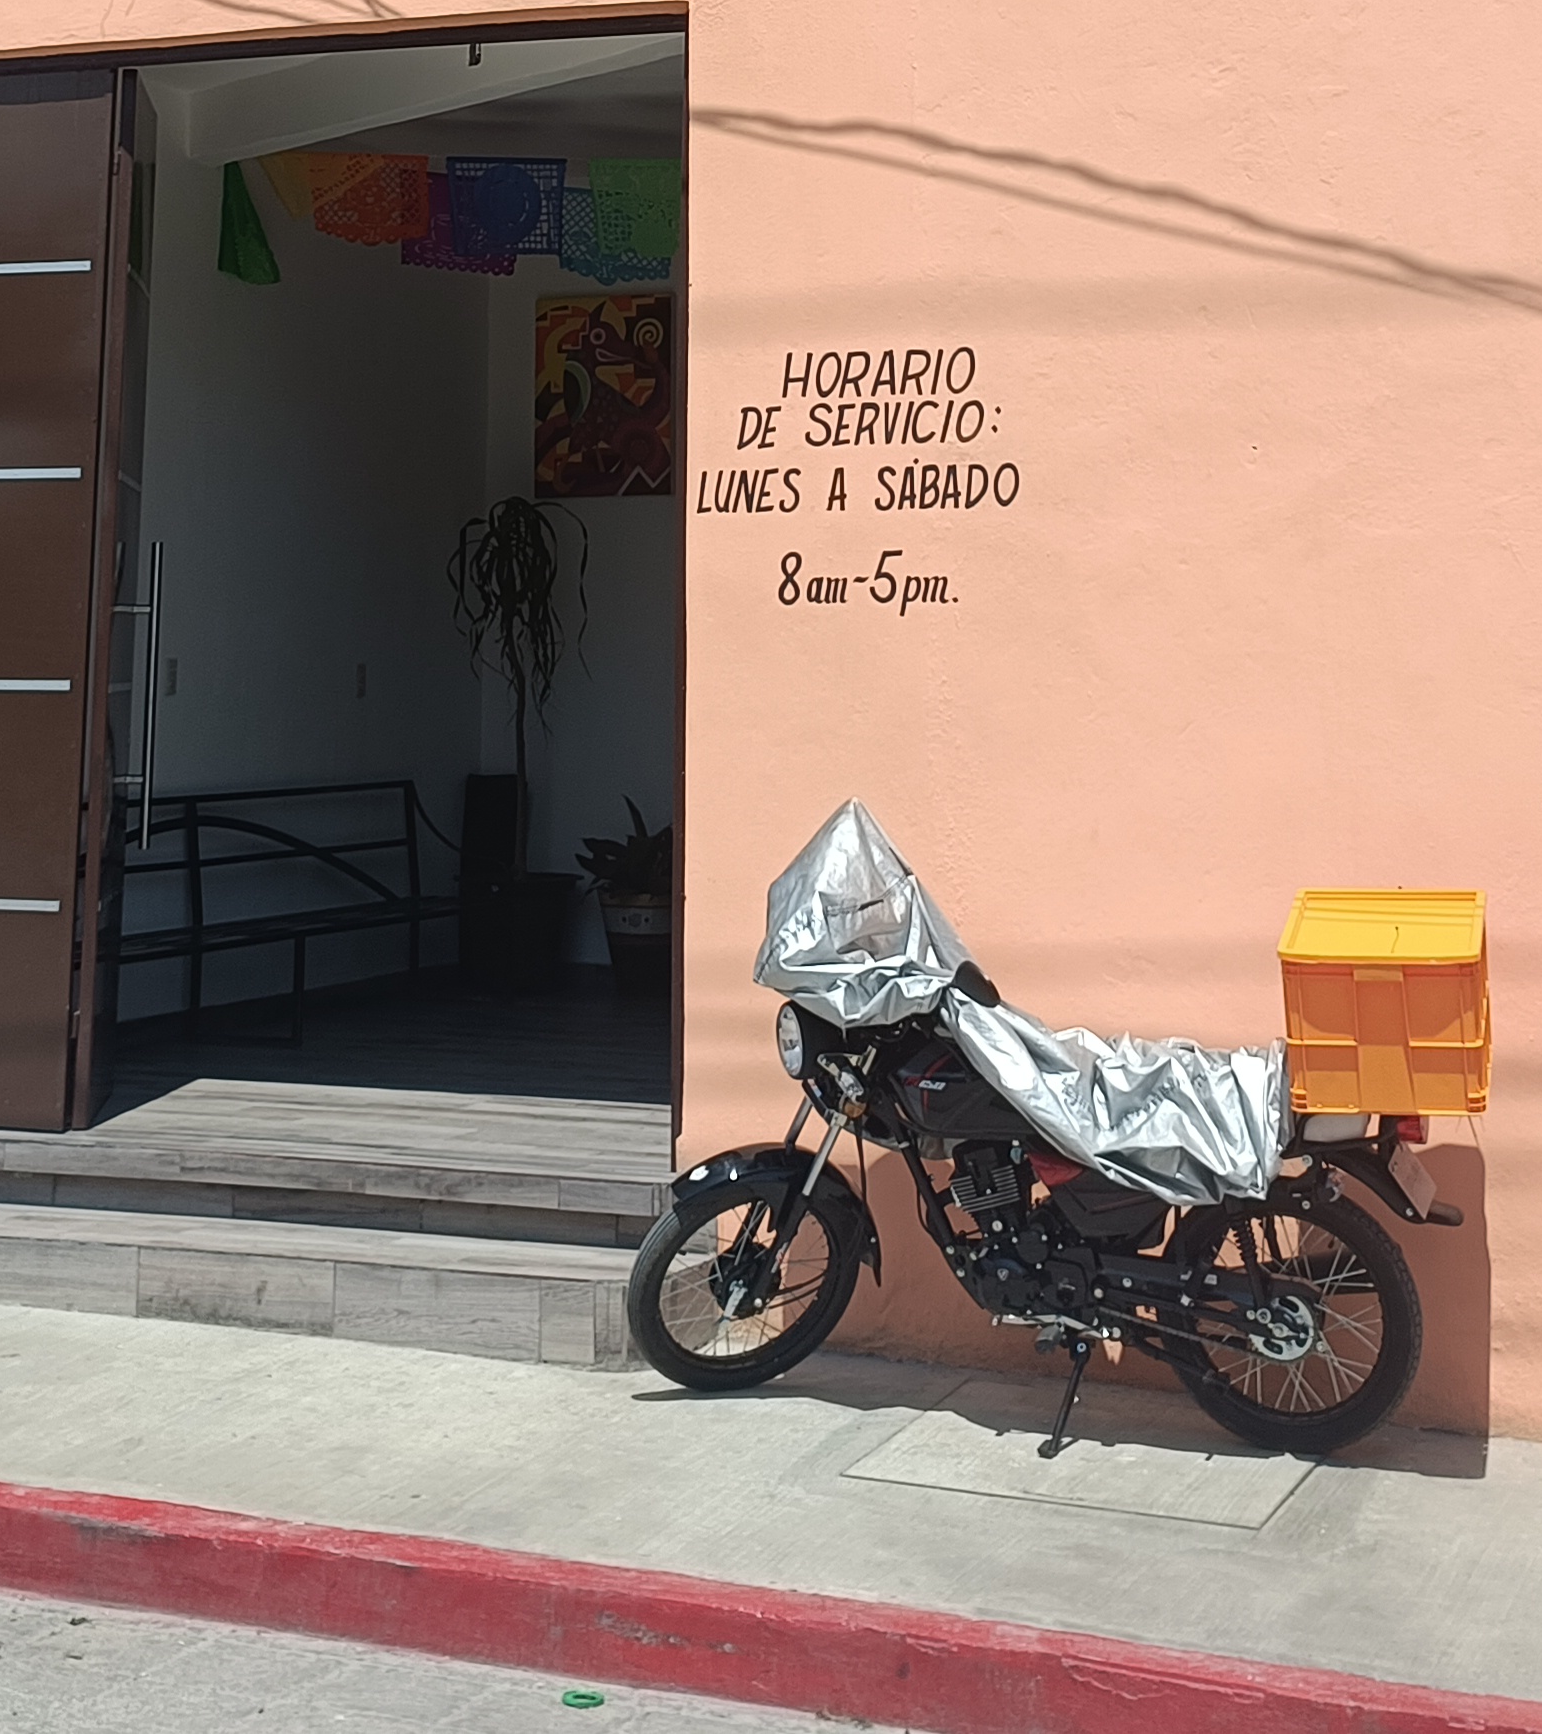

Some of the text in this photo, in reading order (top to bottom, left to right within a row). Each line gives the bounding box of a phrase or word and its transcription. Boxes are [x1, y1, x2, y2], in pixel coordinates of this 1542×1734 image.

[781, 346, 976, 399] HORARIO
[736, 399, 1002, 451] DE SERVICIO:
[696, 468, 802, 515] LUNES
[826, 467, 847, 512] A
